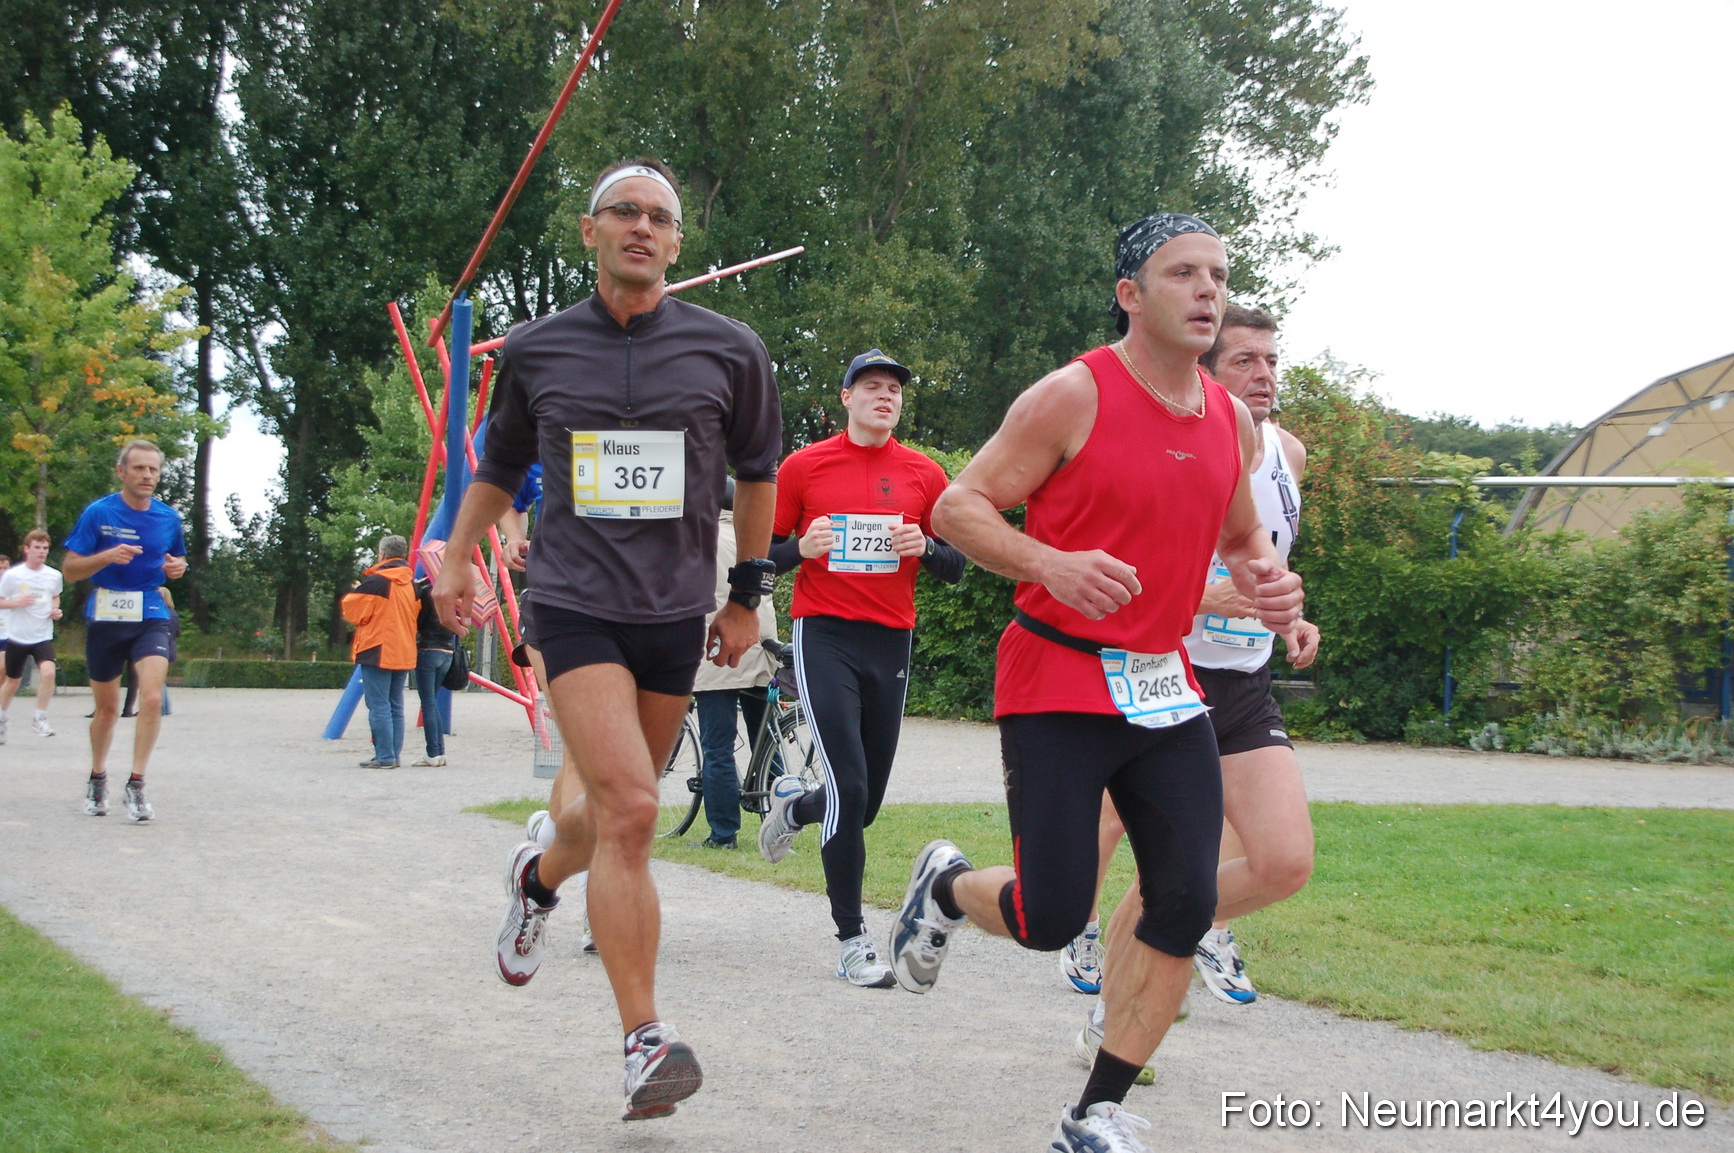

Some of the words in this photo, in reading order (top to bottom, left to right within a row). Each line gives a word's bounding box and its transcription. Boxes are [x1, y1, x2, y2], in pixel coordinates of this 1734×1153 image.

[603, 440, 640, 455] Klaus
[578, 465, 585, 477] B
[614, 466, 665, 490] 367
[641, 505, 682, 514] PFLEIDERER
[851, 520, 882, 532] Jürgen
[851, 537, 893, 552] 2729
[112, 599, 134, 610] 420
[1138, 674, 1183, 702] 2465
